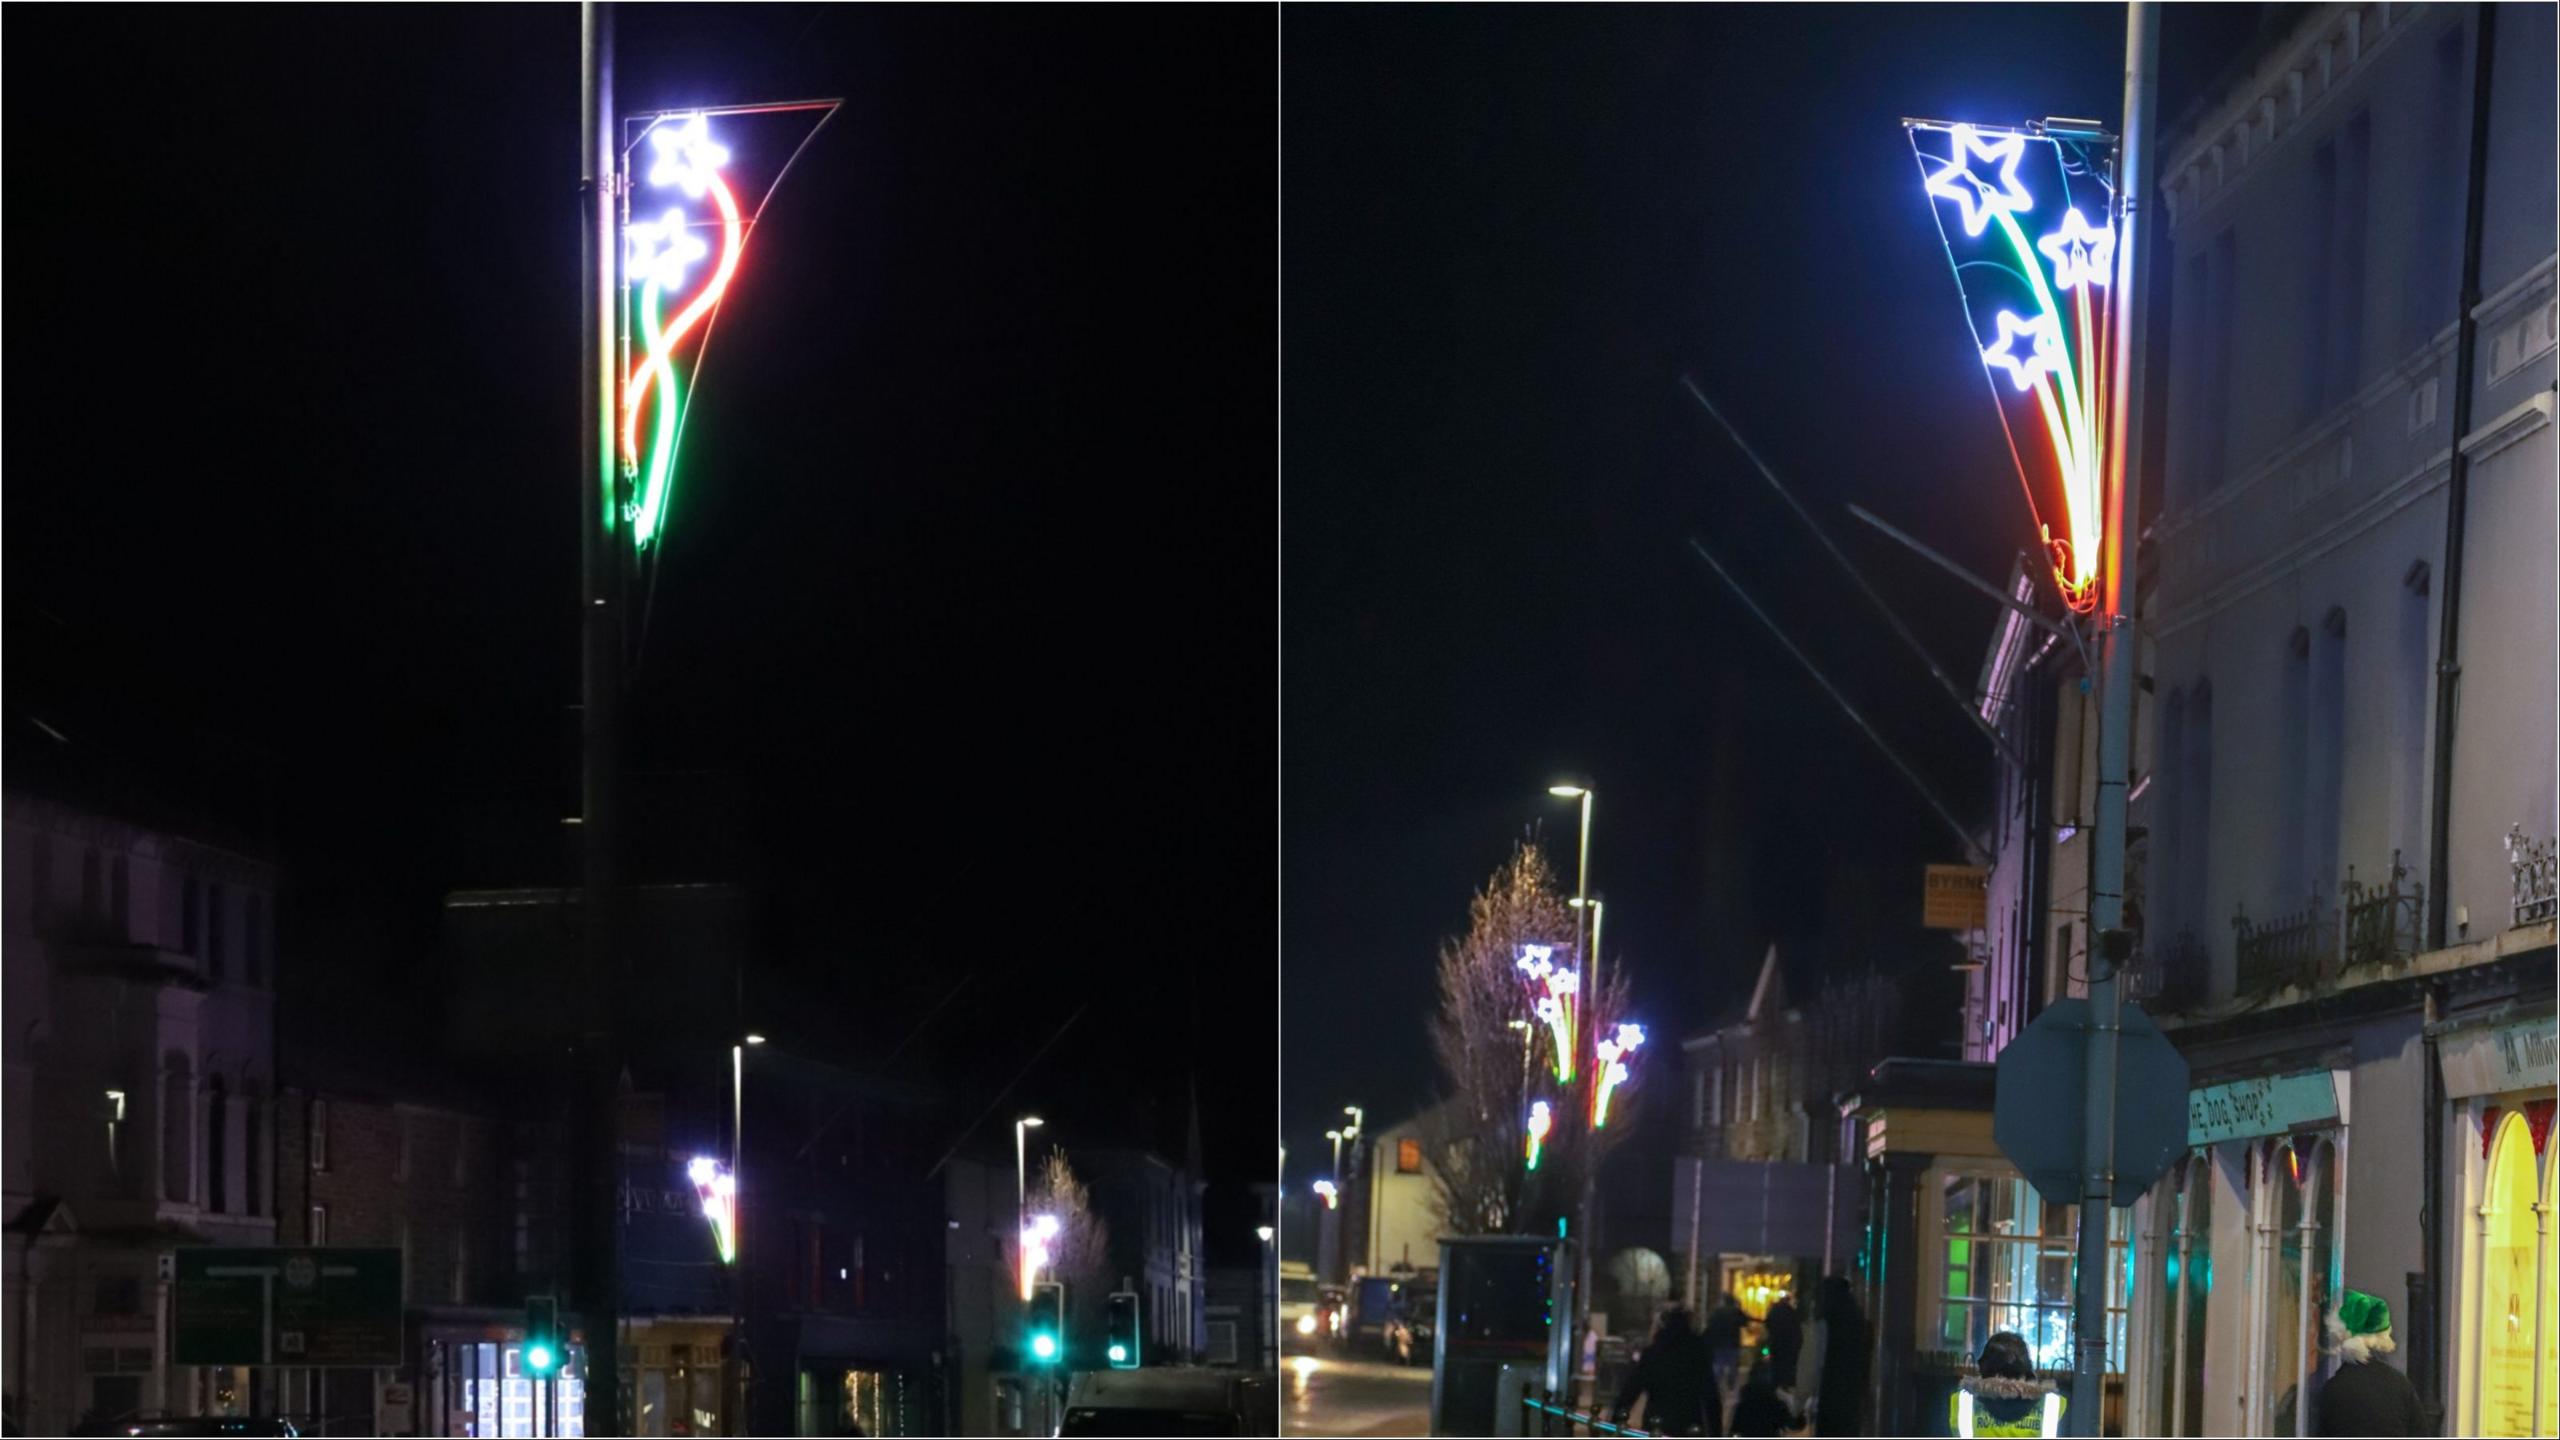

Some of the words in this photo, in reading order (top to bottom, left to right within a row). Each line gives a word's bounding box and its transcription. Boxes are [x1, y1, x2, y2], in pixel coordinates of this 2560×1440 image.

[2190, 1102, 2204, 1129] HE
[2207, 1098, 2230, 1127] DOG
[2233, 1092, 2259, 1123] SHOP
